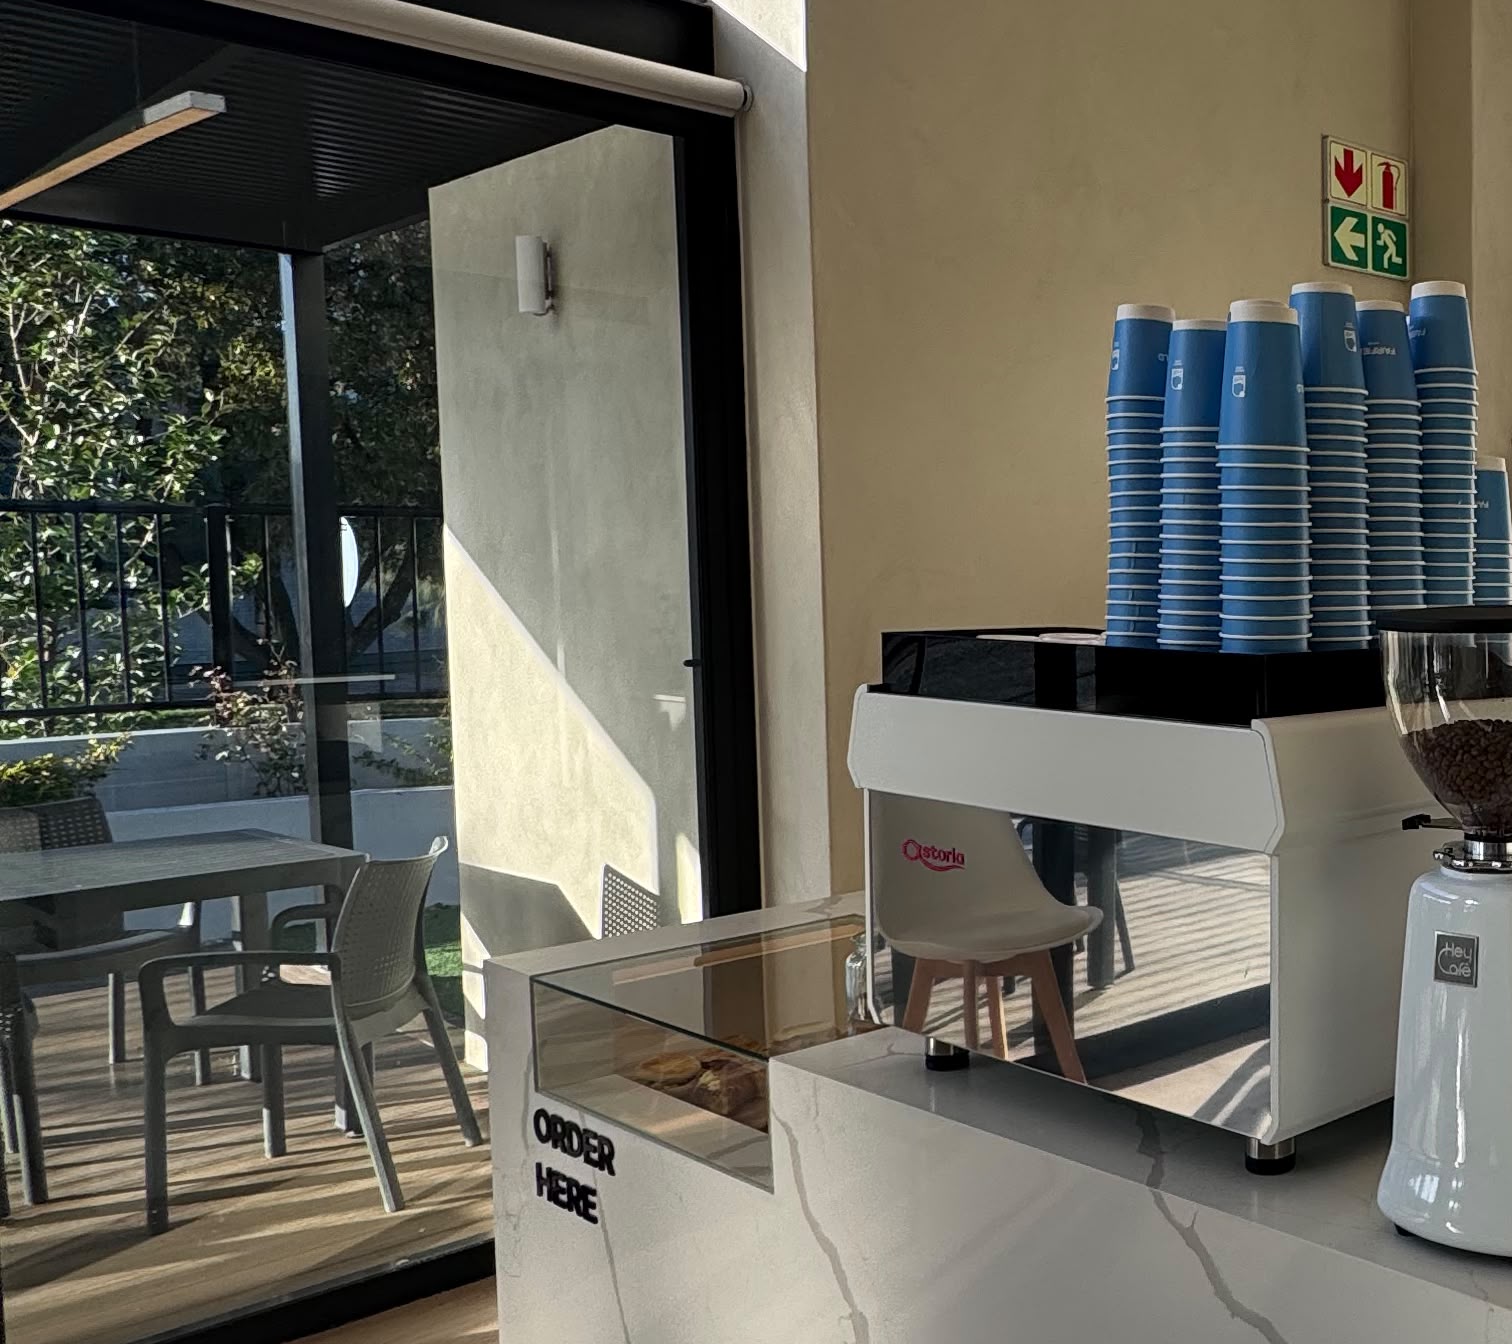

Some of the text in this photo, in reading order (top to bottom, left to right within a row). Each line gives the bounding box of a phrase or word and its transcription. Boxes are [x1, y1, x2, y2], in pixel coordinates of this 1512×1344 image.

[1444, 941, 1473, 963] Hey
[533, 1108, 616, 1176] ORDER
[535, 1162, 599, 1225] HERE
